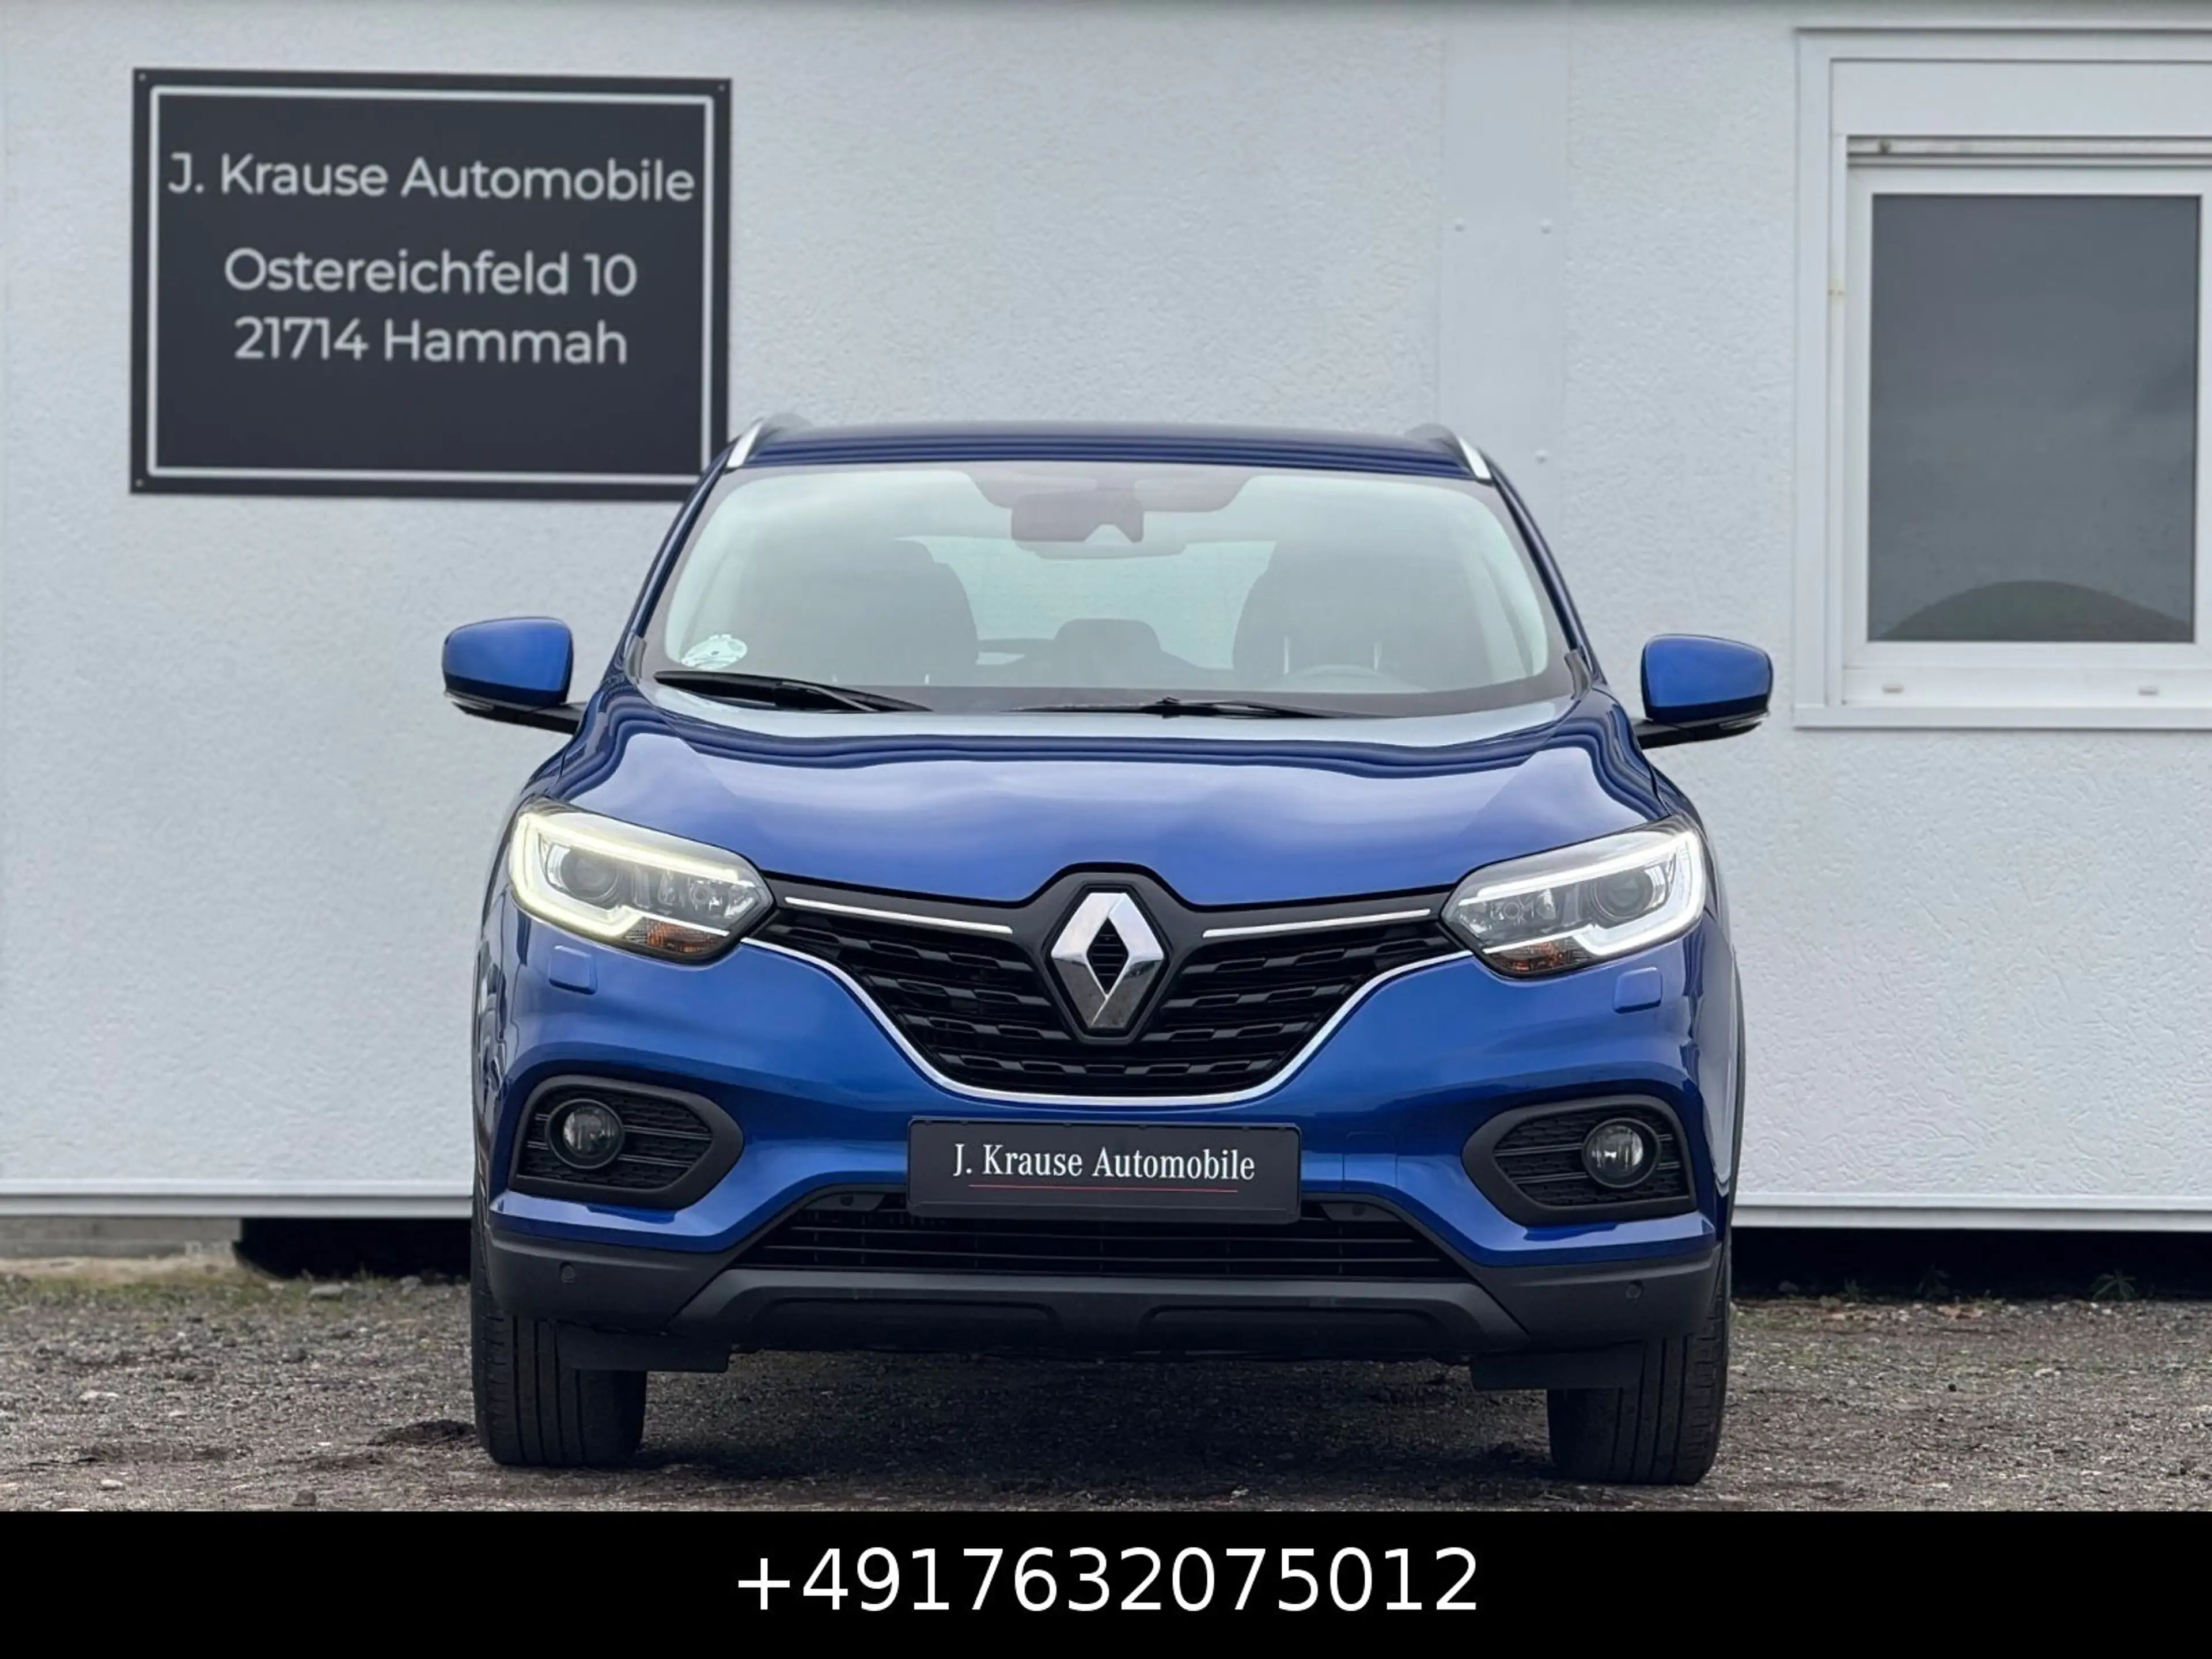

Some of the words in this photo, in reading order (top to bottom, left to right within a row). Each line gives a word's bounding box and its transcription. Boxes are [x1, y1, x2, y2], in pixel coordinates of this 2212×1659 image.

[169, 153, 203, 192] J.
[222, 154, 387, 195] Krause
[402, 158, 694, 200] Automobile
[226, 249, 567, 294] Ostereichfeld
[585, 255, 636, 295] 10
[236, 317, 367, 358] 21714
[386, 320, 626, 362] Hammah
[954, 1144, 971, 1176] J.
[983, 1145, 1082, 1176] Krause
[1092, 1147, 1254, 1179] Automobile
